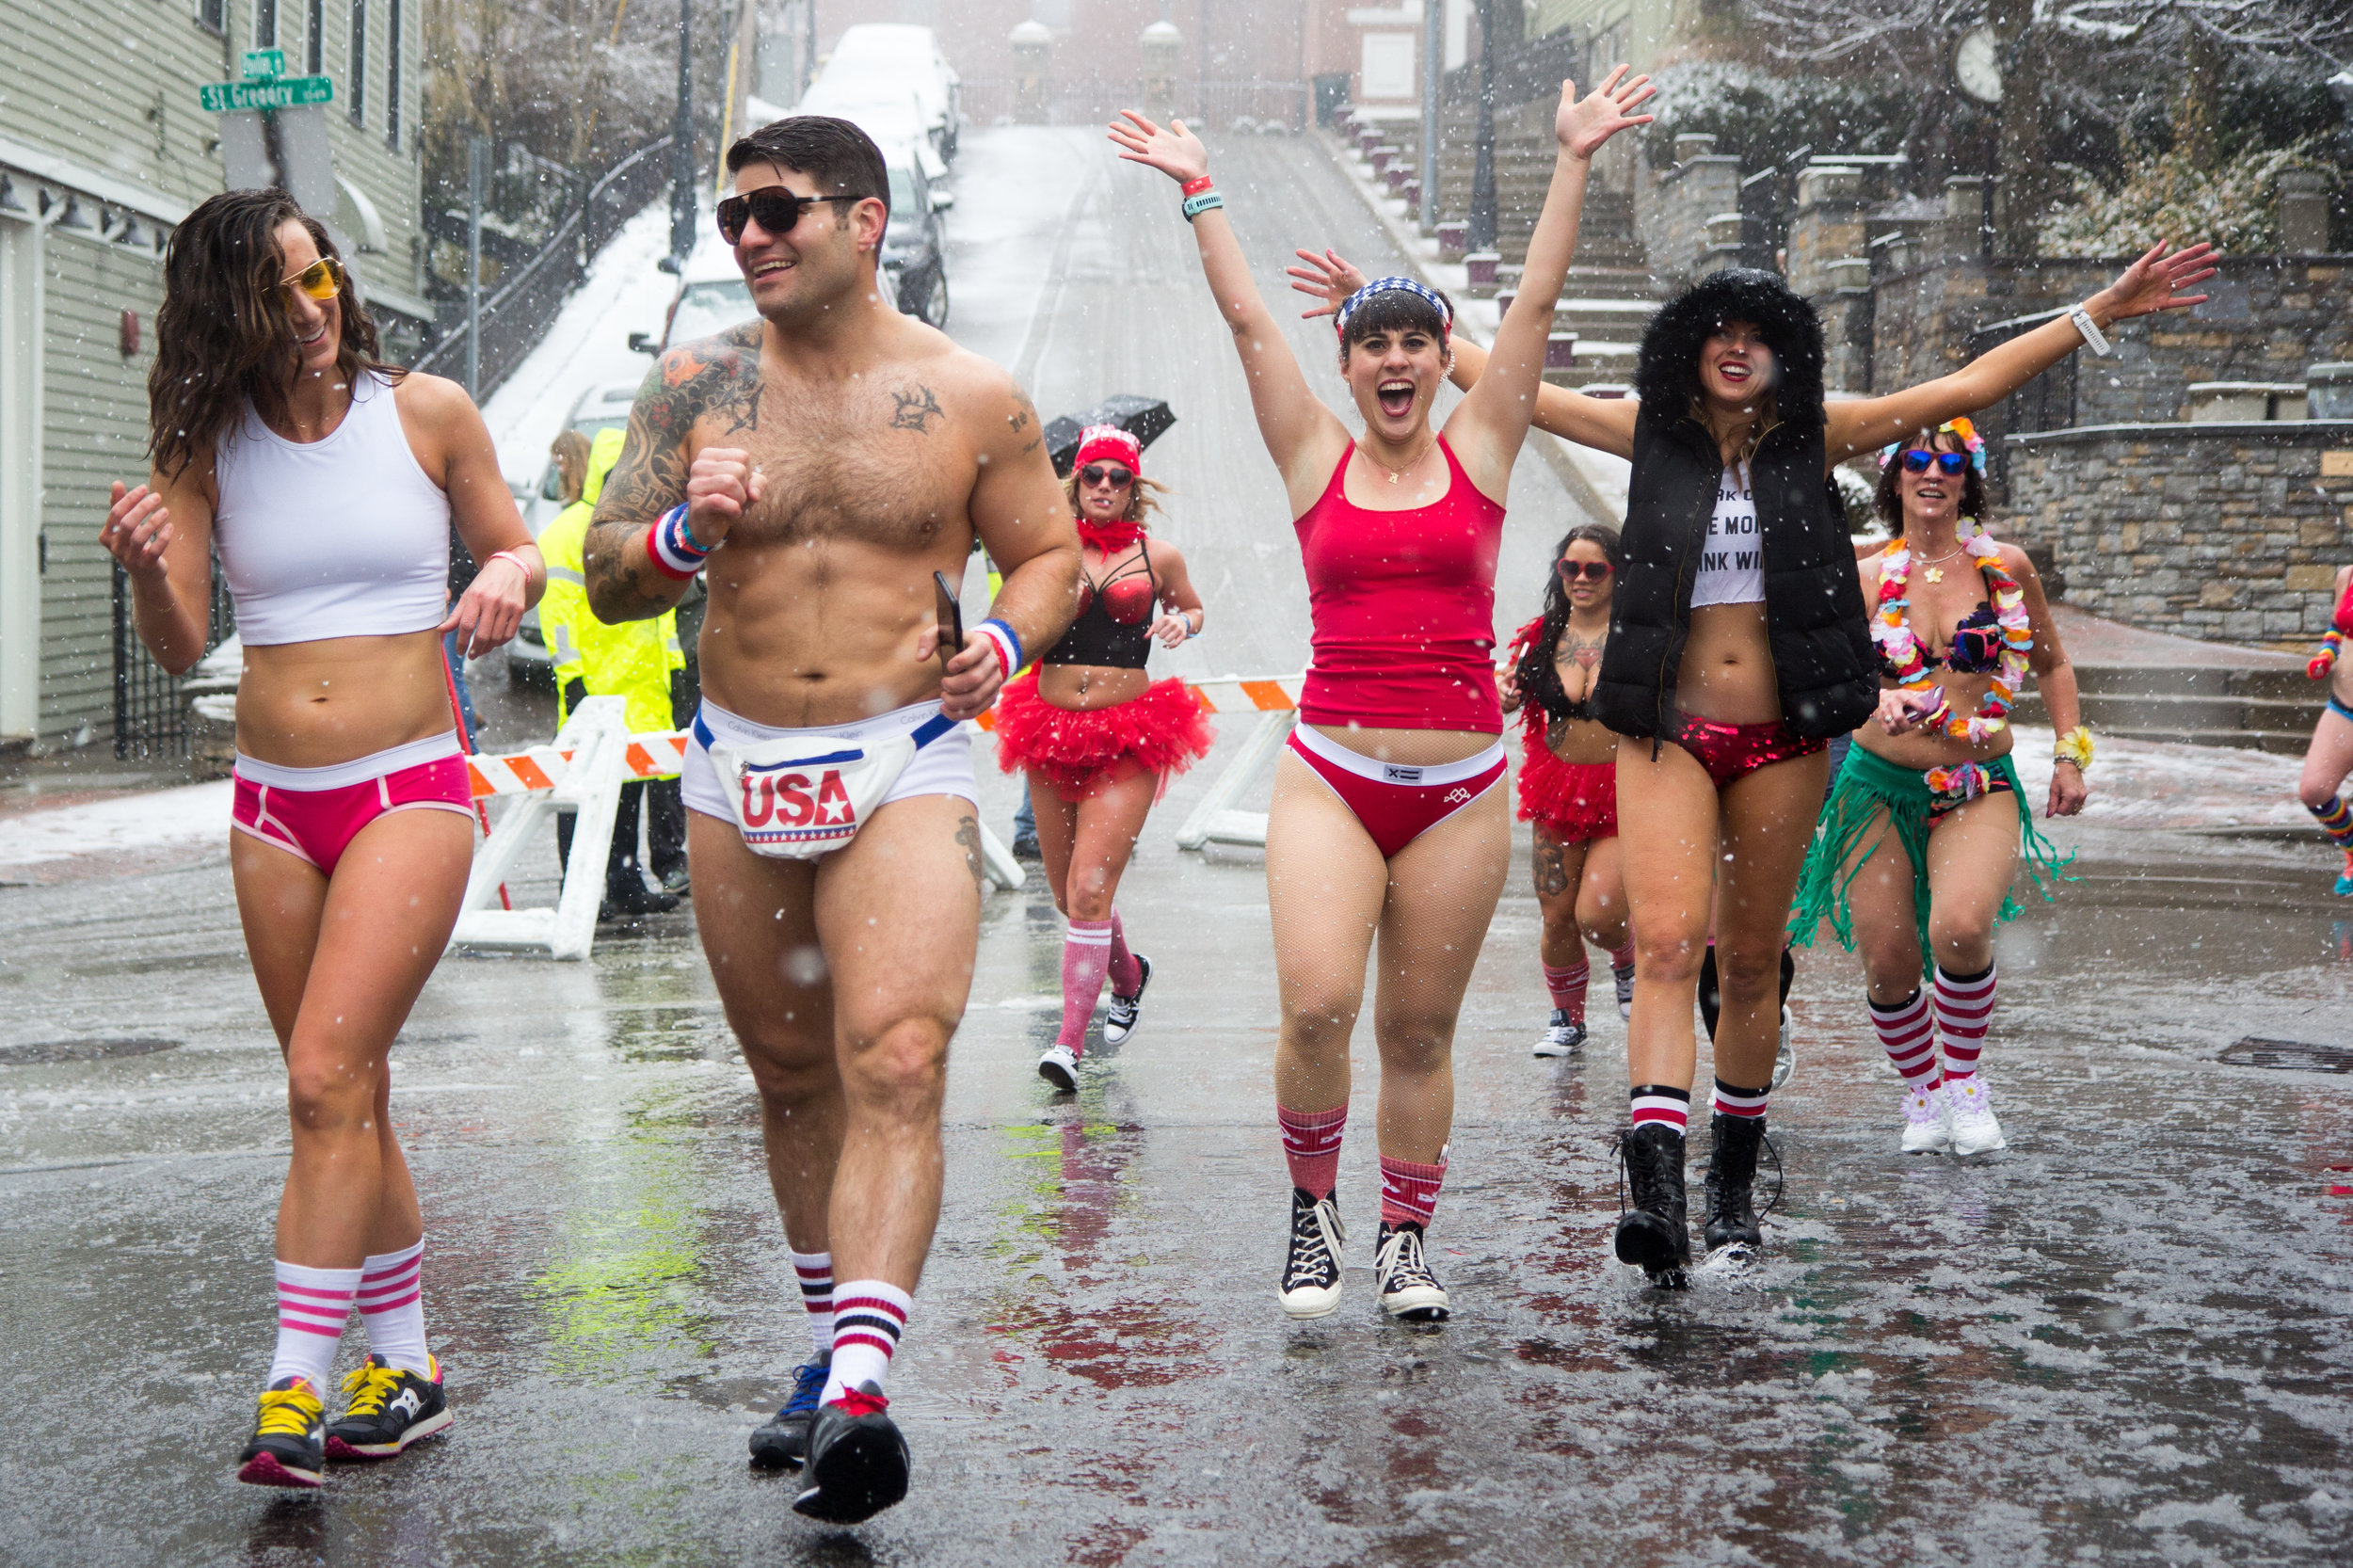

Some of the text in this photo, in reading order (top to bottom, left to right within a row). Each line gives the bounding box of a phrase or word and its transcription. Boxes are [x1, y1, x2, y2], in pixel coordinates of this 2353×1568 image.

[232, 84, 294, 107] Gregory
[728, 720, 770, 741] Calvin Klein
[840, 729, 864, 740] Klein
[741, 769, 856, 828] USA
